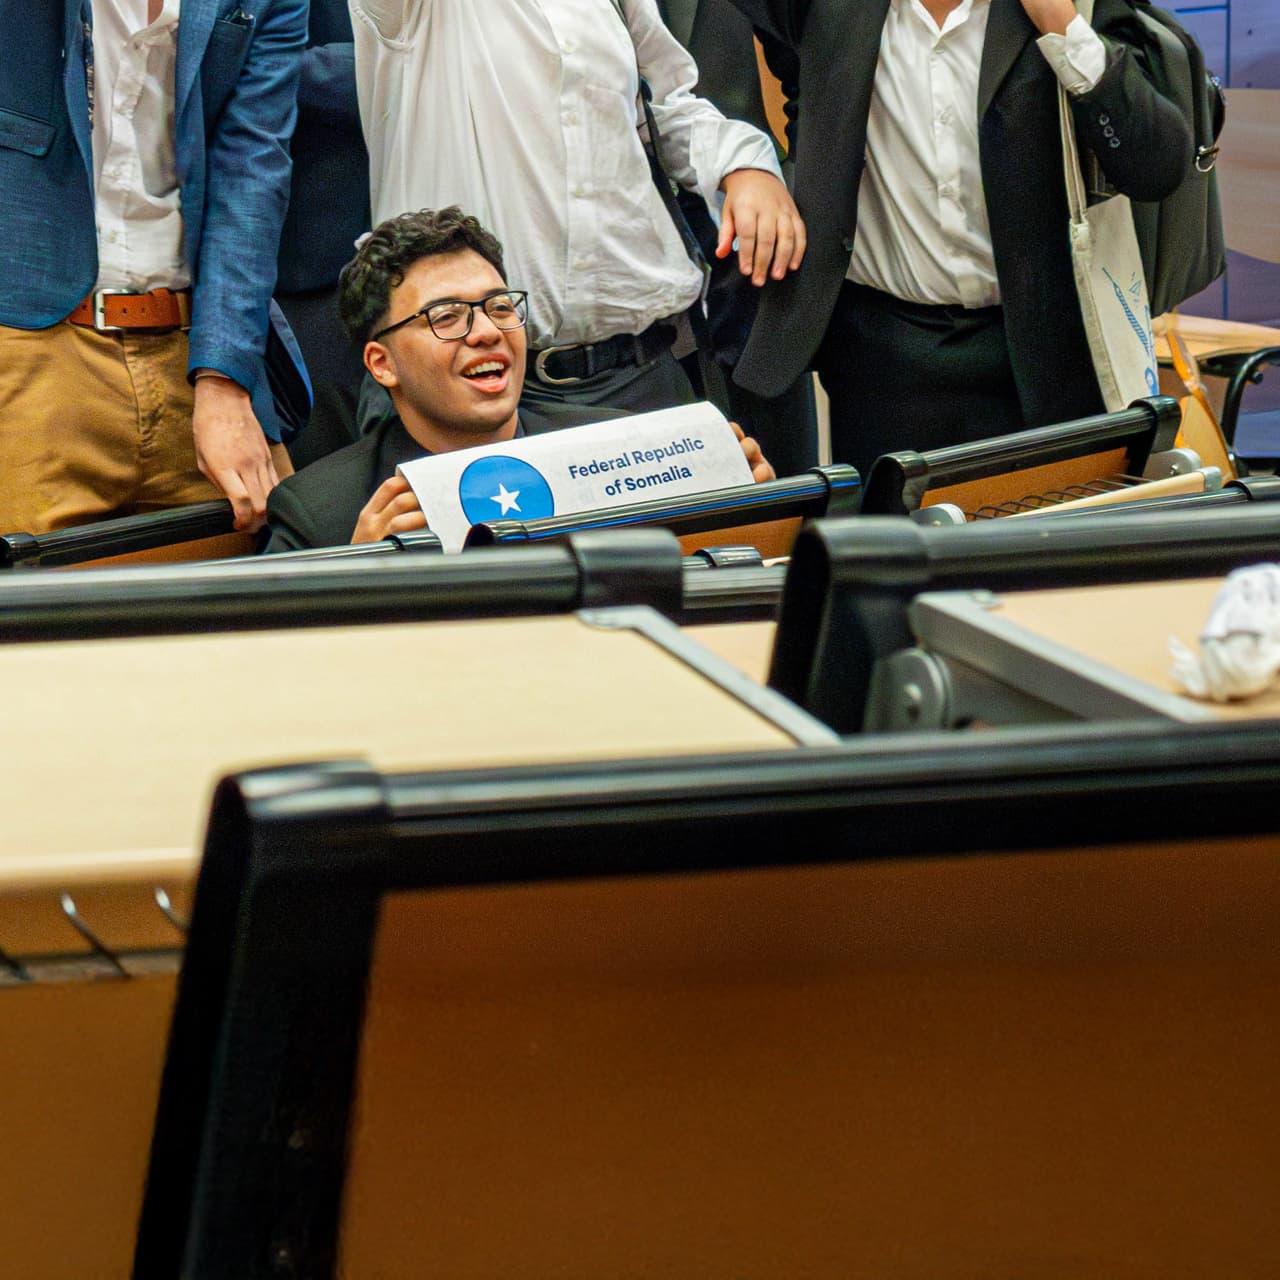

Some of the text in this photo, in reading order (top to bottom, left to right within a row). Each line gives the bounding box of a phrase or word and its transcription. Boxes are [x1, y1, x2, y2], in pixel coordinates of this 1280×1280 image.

[568, 438, 705, 479] Federal Republic
[605, 465, 693, 496] of Somalia
